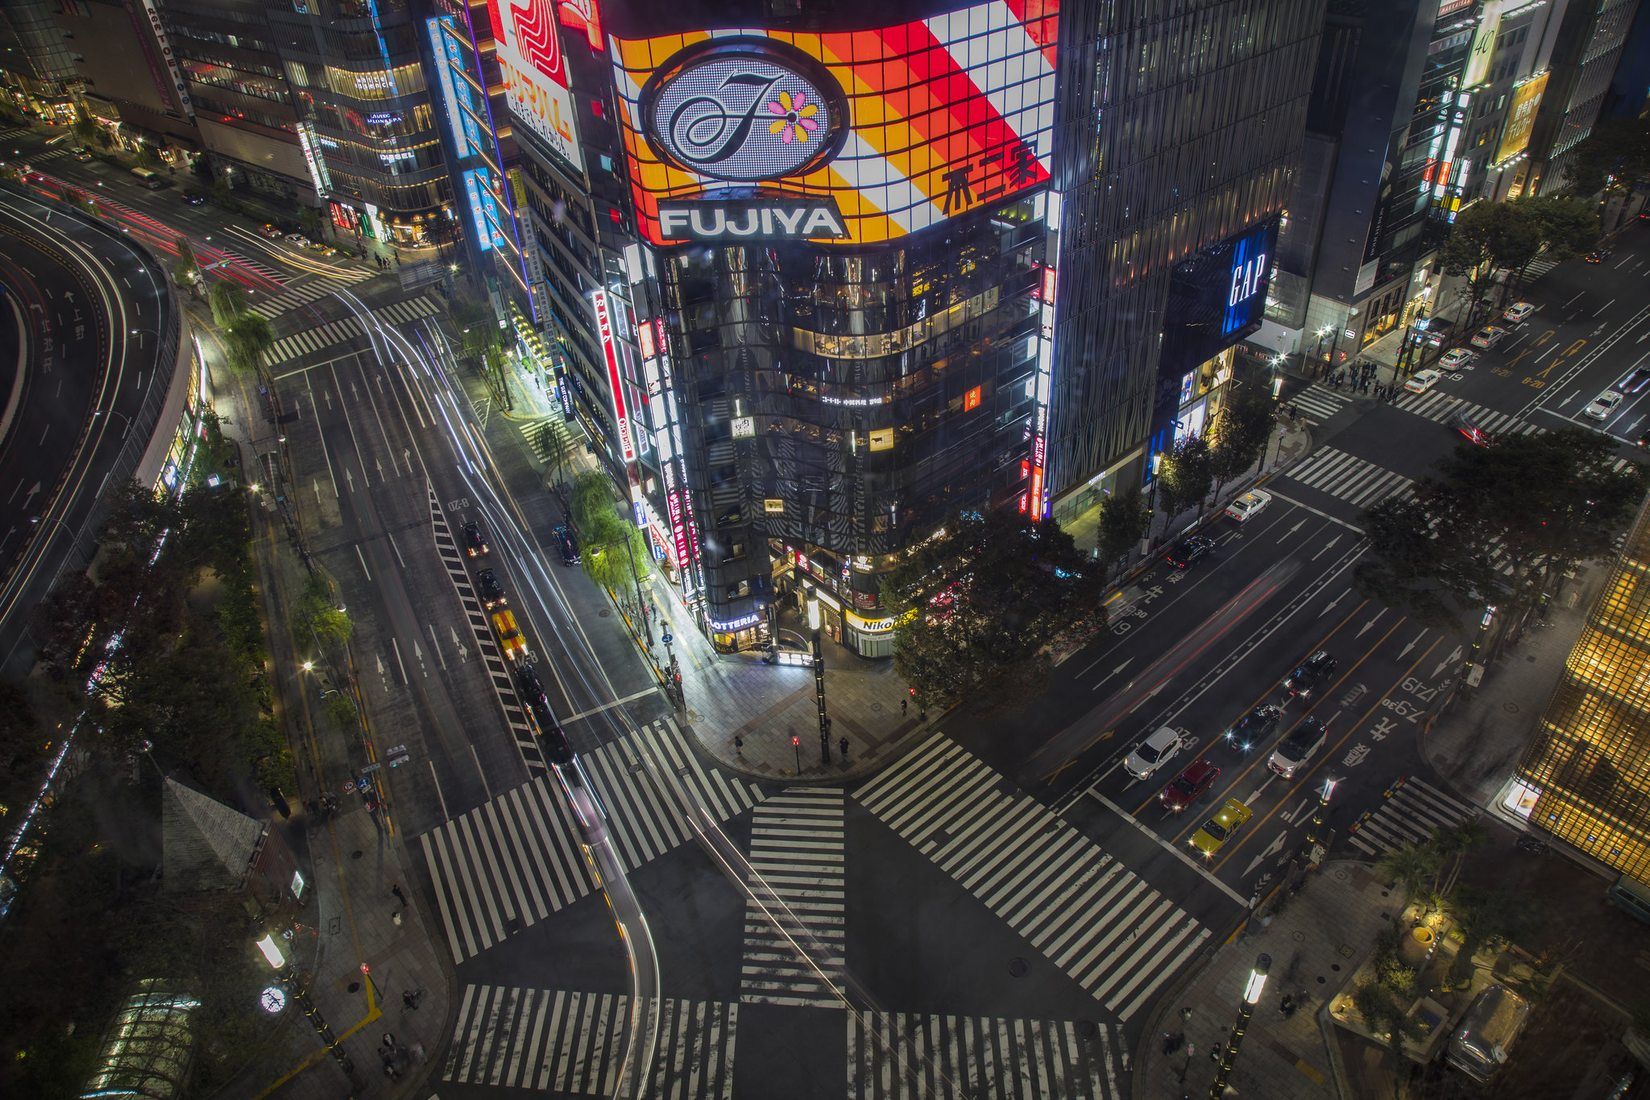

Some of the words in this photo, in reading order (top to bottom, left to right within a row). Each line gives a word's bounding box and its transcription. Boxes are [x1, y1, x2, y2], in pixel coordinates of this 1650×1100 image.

[379, 152, 415, 161] DIESEL
[942, 141, 1037, 216] 不二家
[661, 208, 842, 237] FUJIYA
[1229, 253, 1266, 308] GAP
[1522, 376, 1547, 389] 8-20
[709, 614, 760, 630] LOTTERIA
